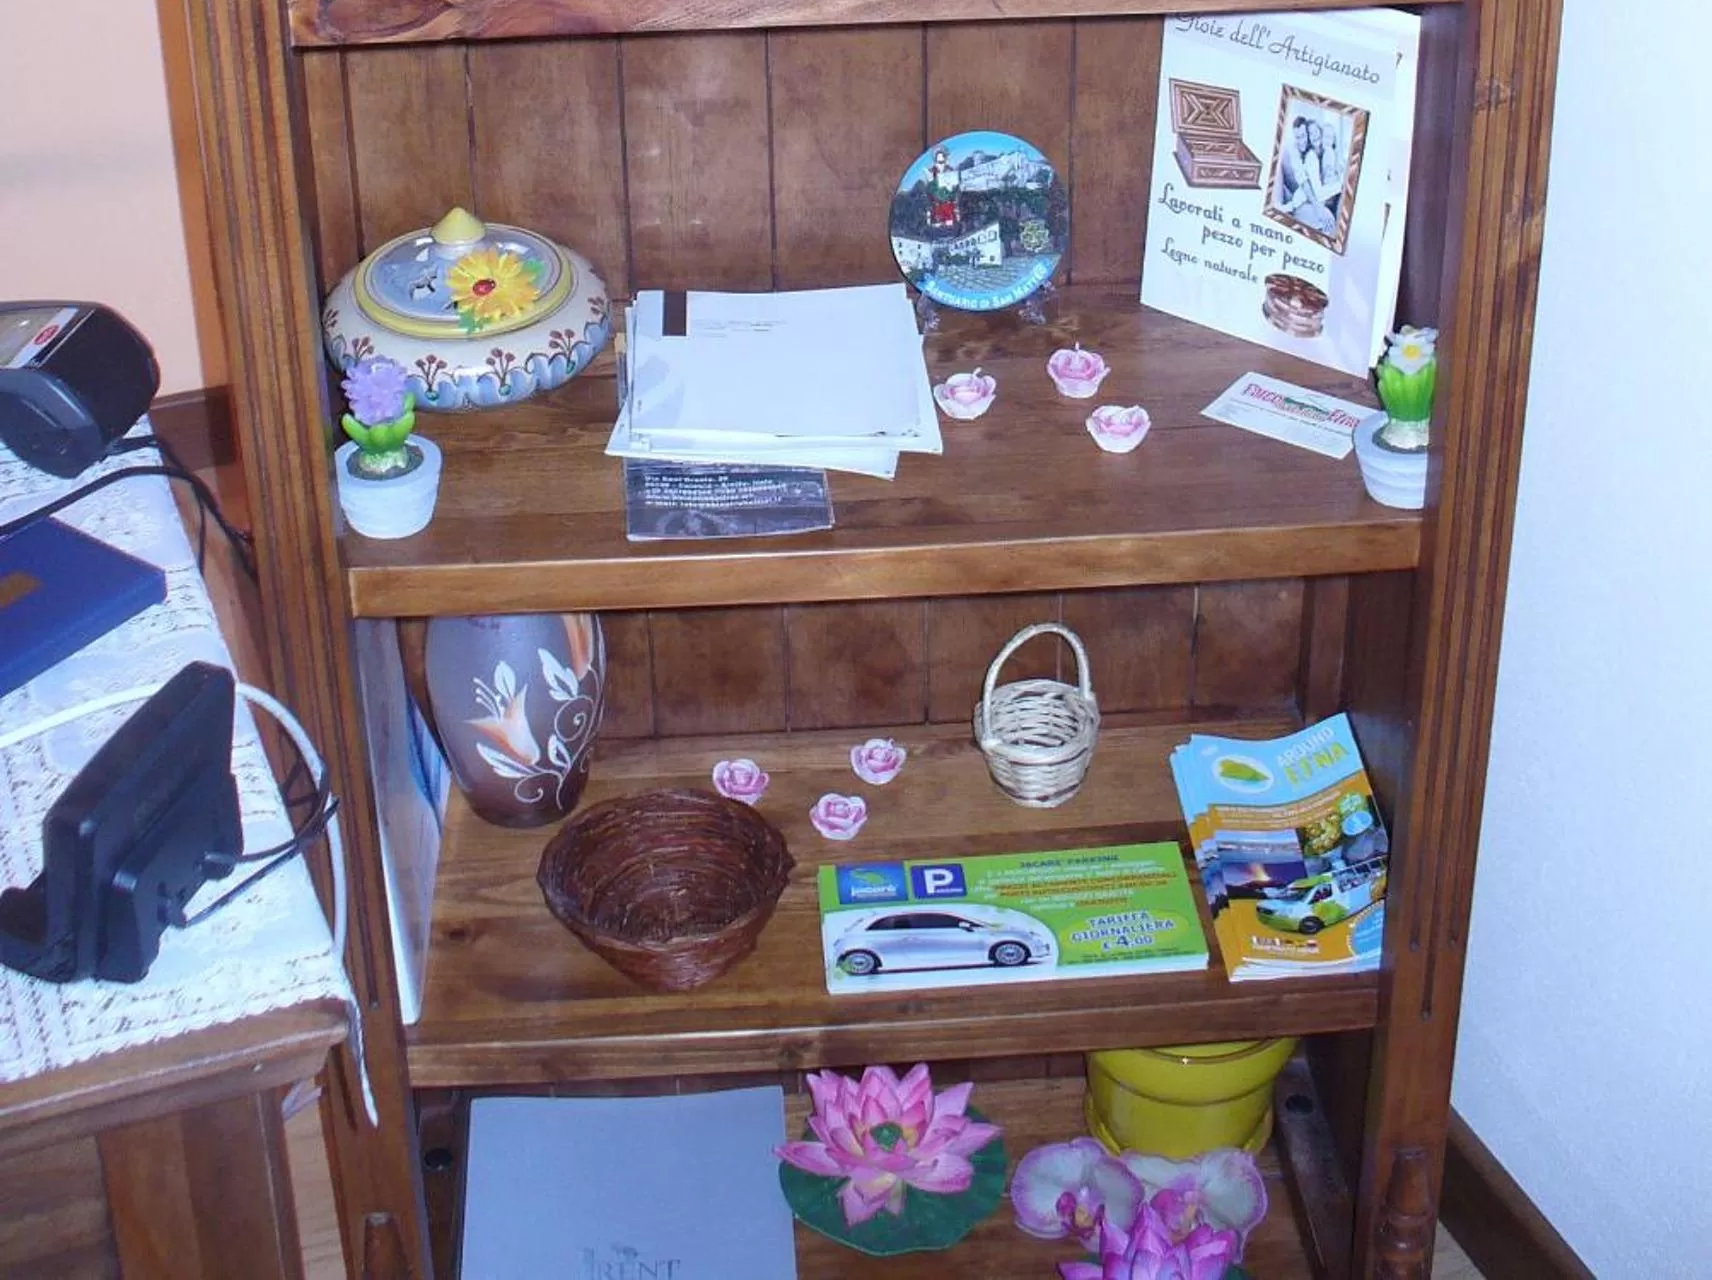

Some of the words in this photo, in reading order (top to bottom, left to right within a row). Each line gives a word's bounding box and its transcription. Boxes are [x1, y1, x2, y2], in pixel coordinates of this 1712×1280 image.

[1231, 217, 1241, 229] a
[1250, 222, 1294, 245] mano
[1160, 236, 1199, 266] Legno
[1203, 258, 1259, 283] naturale
[1201, 225, 1244, 249] pezzo
[1249, 240, 1277, 260] per
[1282, 251, 1325, 274] pezzo
[1276, 726, 1335, 769] AROUND
[1283, 741, 1349, 787] ETNA
[923, 867, 954, 895] P
[1071, 918, 1174, 942] GIORNALIERA
[1089, 911, 1150, 927] TARIFFA
